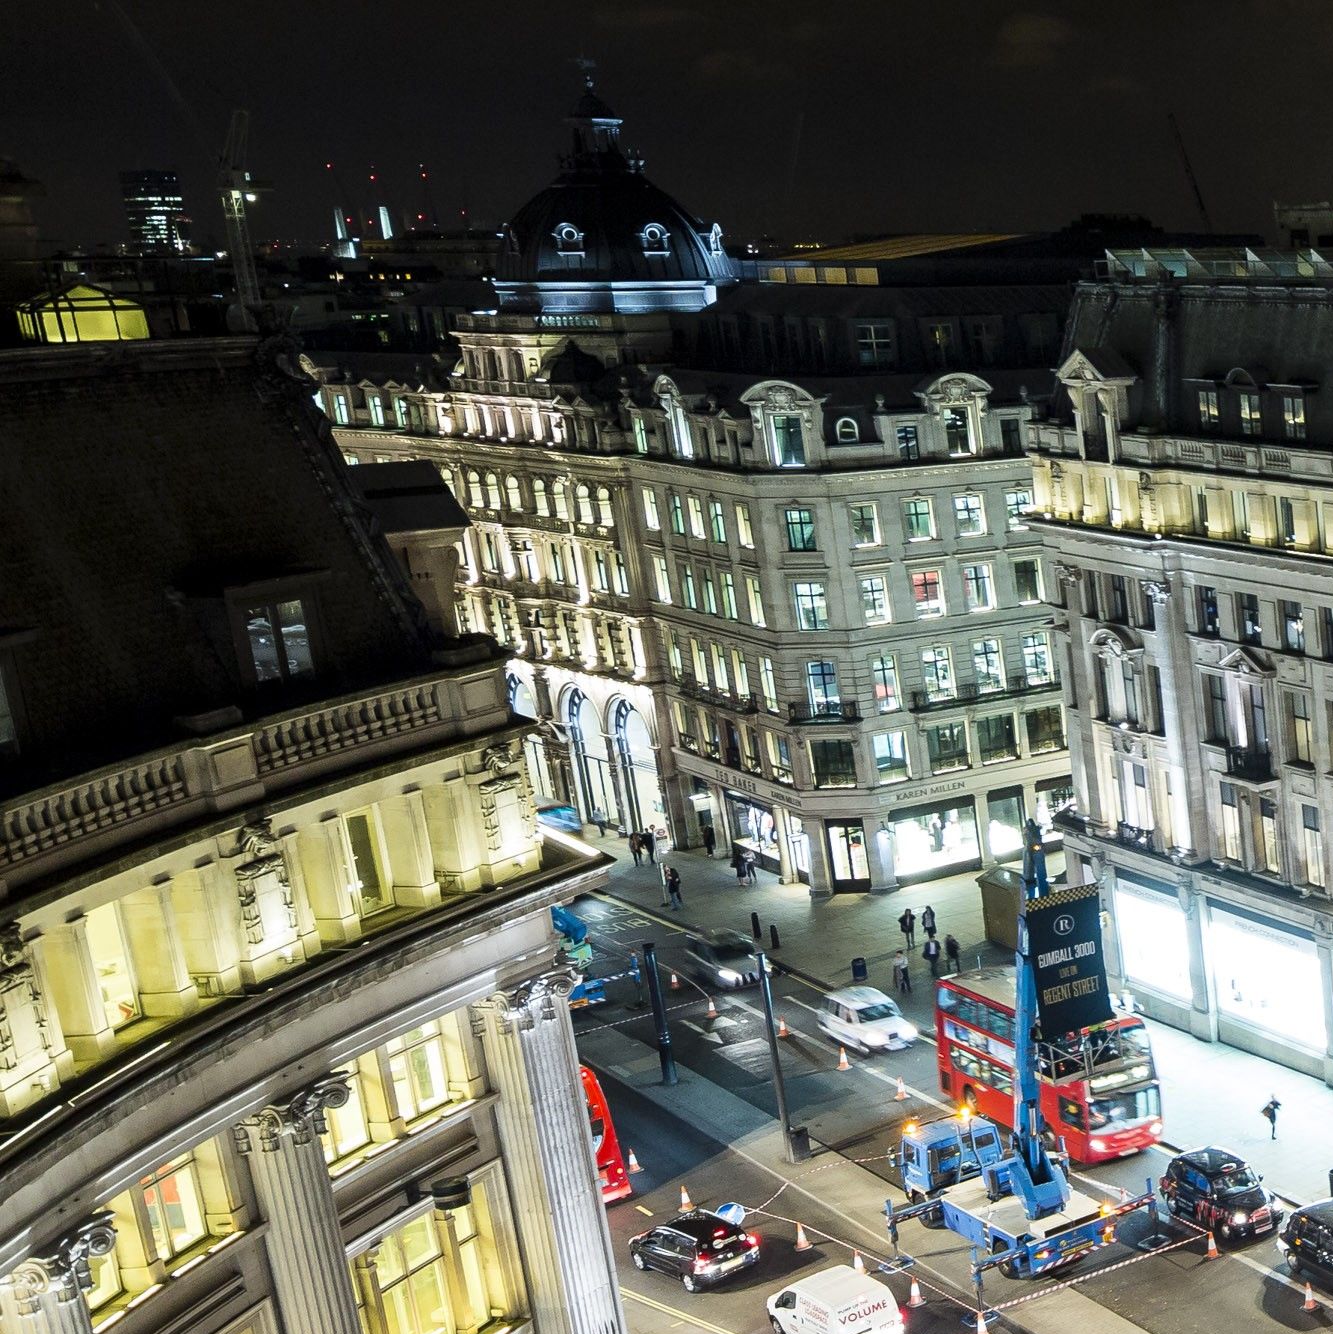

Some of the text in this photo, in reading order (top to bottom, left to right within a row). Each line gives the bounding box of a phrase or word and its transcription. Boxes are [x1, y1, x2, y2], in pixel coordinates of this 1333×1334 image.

[895, 781, 965, 802] KAREN MILLEN
[1038, 941, 1096, 969] GUMBALL 3000
[1043, 975, 1100, 1005] REGENT STREET
[838, 1299, 888, 1326] VOLUME
